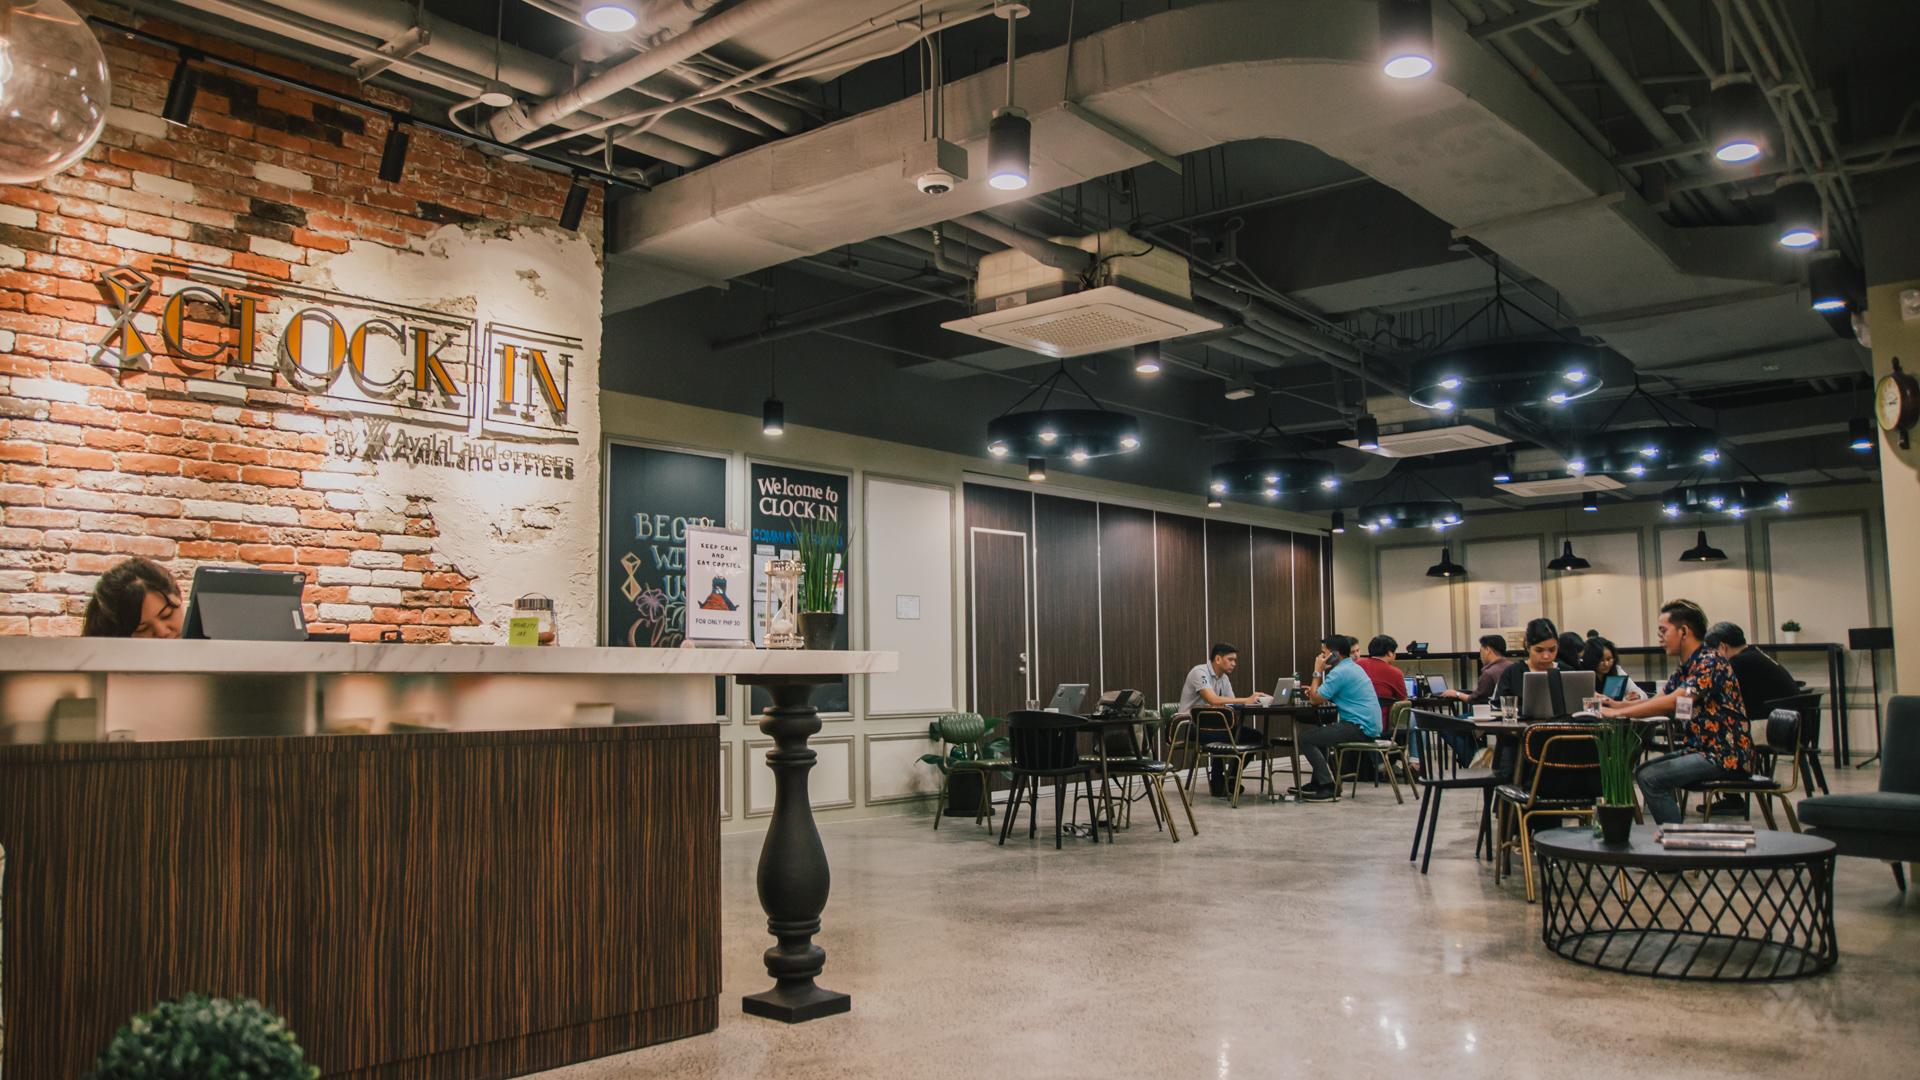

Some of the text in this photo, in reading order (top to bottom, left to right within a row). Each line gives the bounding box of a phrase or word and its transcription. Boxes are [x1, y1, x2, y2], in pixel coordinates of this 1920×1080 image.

[164, 286, 574, 413] CLOCK IN
[393, 428, 497, 460] AyalaLand
[757, 477, 839, 503] Welcome to
[759, 497, 838, 522] CLOCK IN
